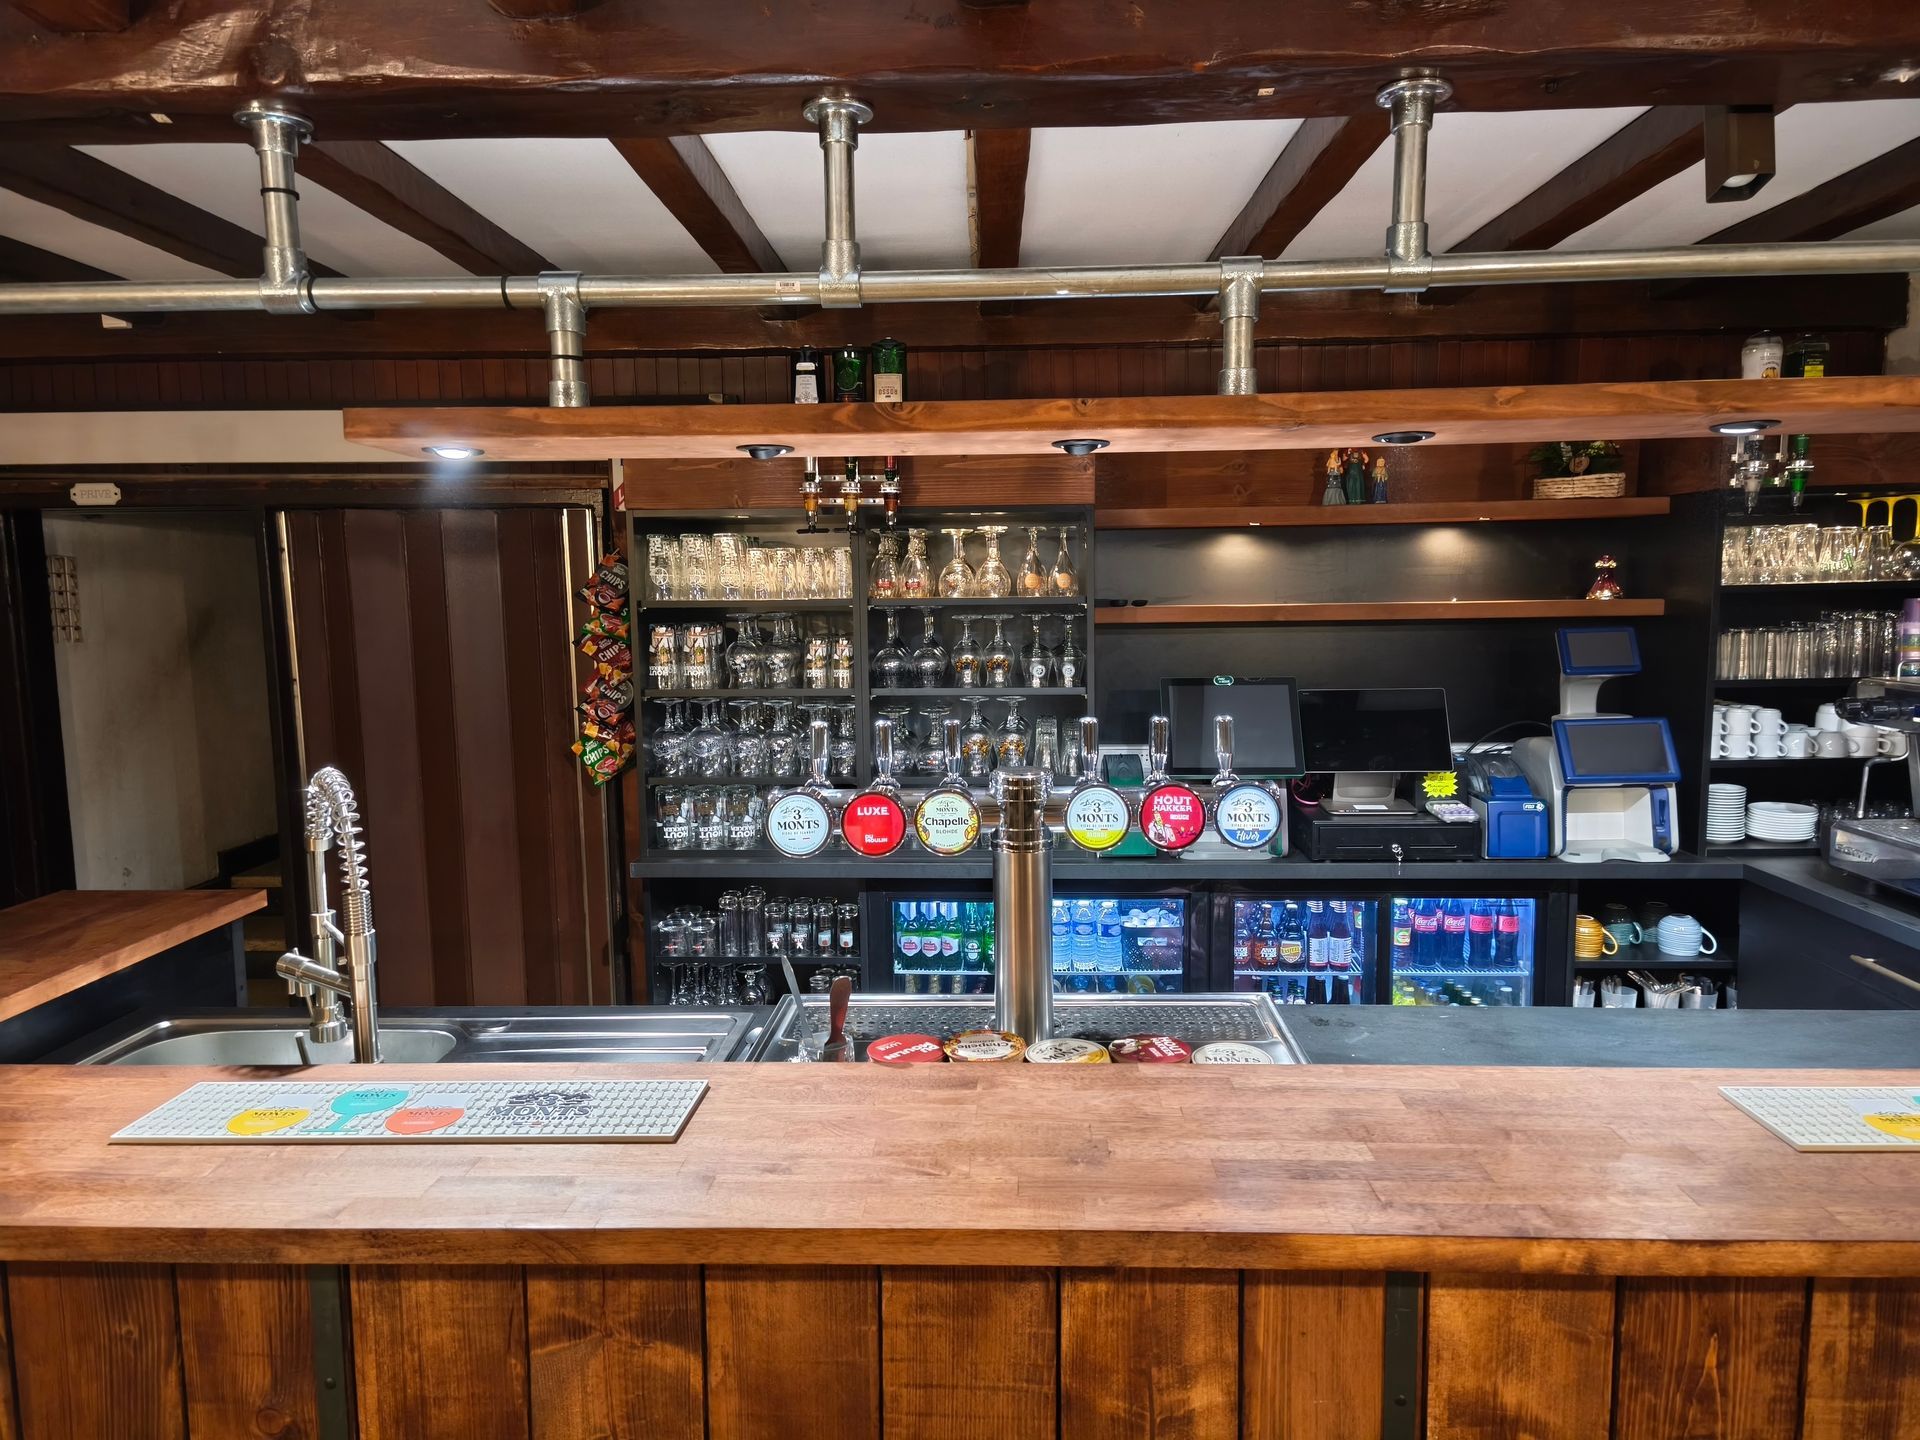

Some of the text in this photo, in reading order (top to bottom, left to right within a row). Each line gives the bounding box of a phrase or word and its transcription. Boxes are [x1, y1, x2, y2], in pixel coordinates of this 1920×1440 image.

[600, 570, 626, 590] CHIPS
[598, 640, 626, 662] CHIPS
[600, 684, 626, 704] CHIPS
[583, 744, 610, 765] CHIPS
[1154, 796, 1192, 805] HOUT
[857, 806, 890, 816] LUXE
[1093, 802, 1102, 813] 3
[1153, 804, 1192, 812] HAKKER
[1244, 802, 1252, 812] 3
[793, 809, 802, 820] 3
[1076, 814, 1119, 822] MONTS
[1227, 813, 1270, 822] MONTS
[777, 820, 820, 831] MONTS
[925, 817, 969, 828] Chapelle
[699, 830, 722, 838] HOUT
[730, 830, 755, 838] HOUT
[1236, 830, 1260, 842] Hiver
[1158, 1036, 1188, 1055] HOUT
[1042, 1045, 1088, 1061] MONTS
[486, 1106, 594, 1116] MONTS
